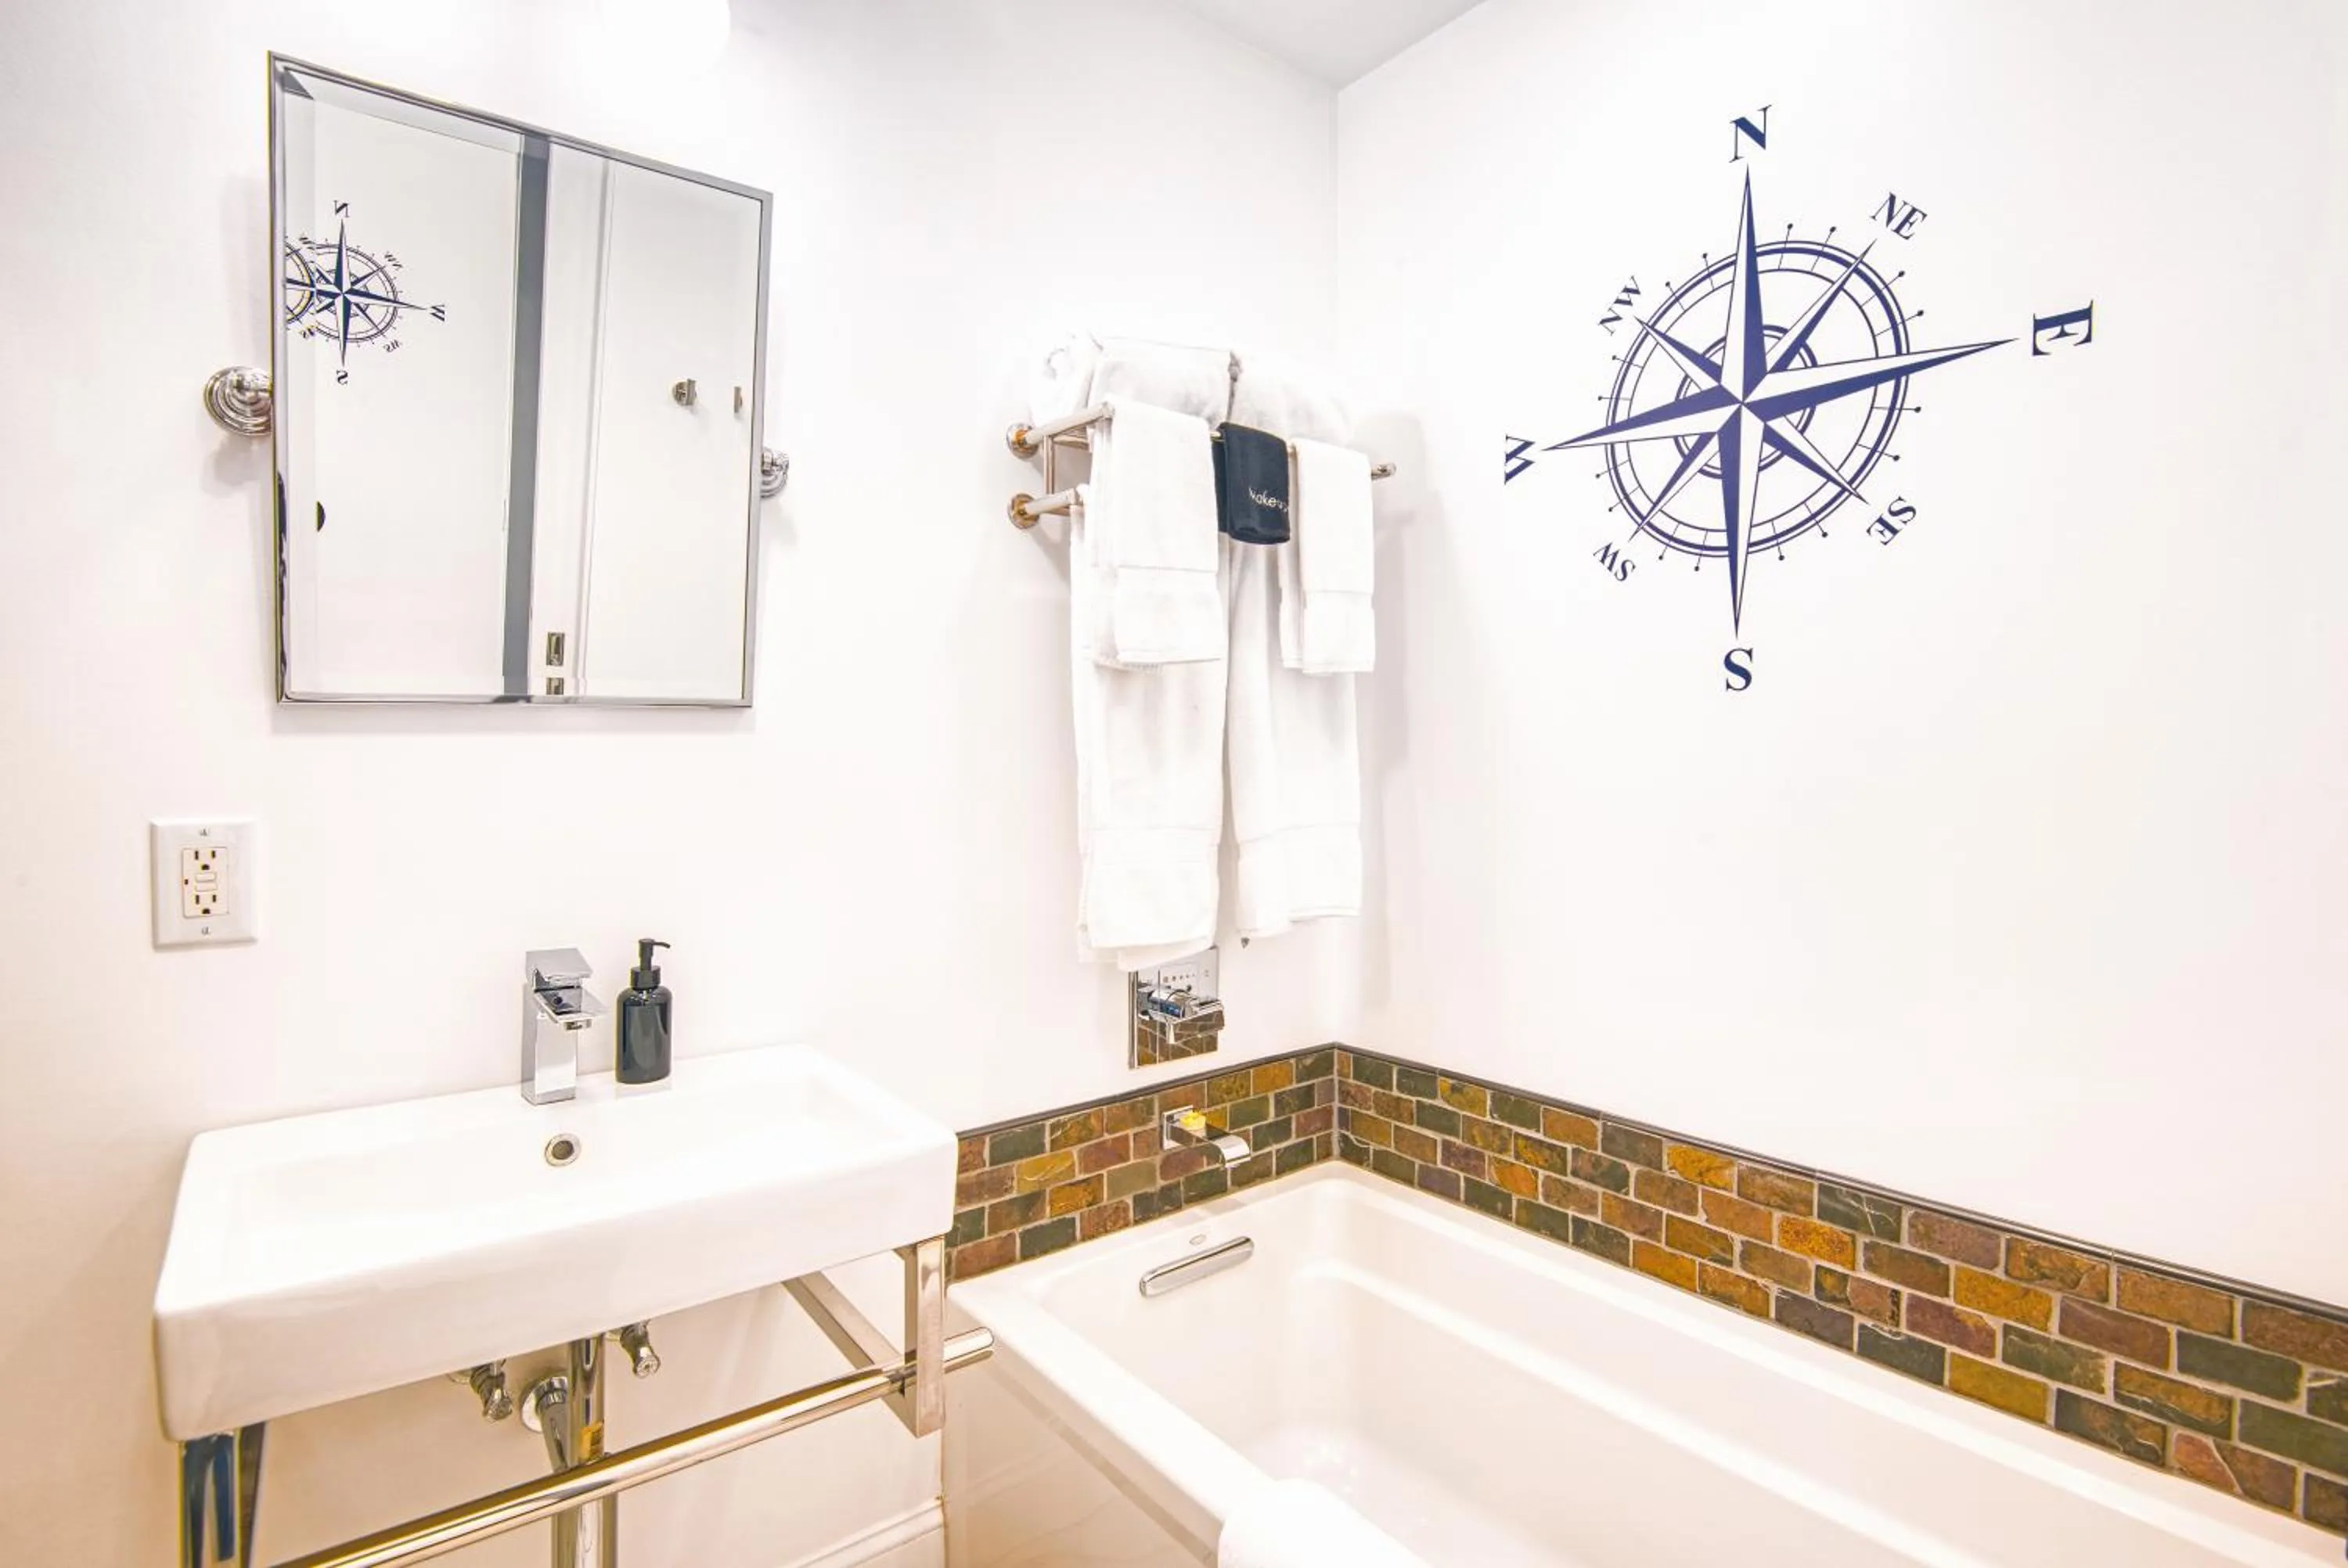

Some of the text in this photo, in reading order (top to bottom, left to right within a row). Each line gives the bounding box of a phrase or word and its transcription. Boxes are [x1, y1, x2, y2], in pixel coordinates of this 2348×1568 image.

[1729, 104, 1772, 163] N
[1869, 192, 1928, 240] NE
[1598, 275, 1641, 337] NW
[2032, 300, 2094, 357] E
[1504, 433, 1536, 485] W
[1866, 496, 1917, 545] SE
[1593, 541, 1636, 581] SW
[1723, 648, 1754, 692] S
